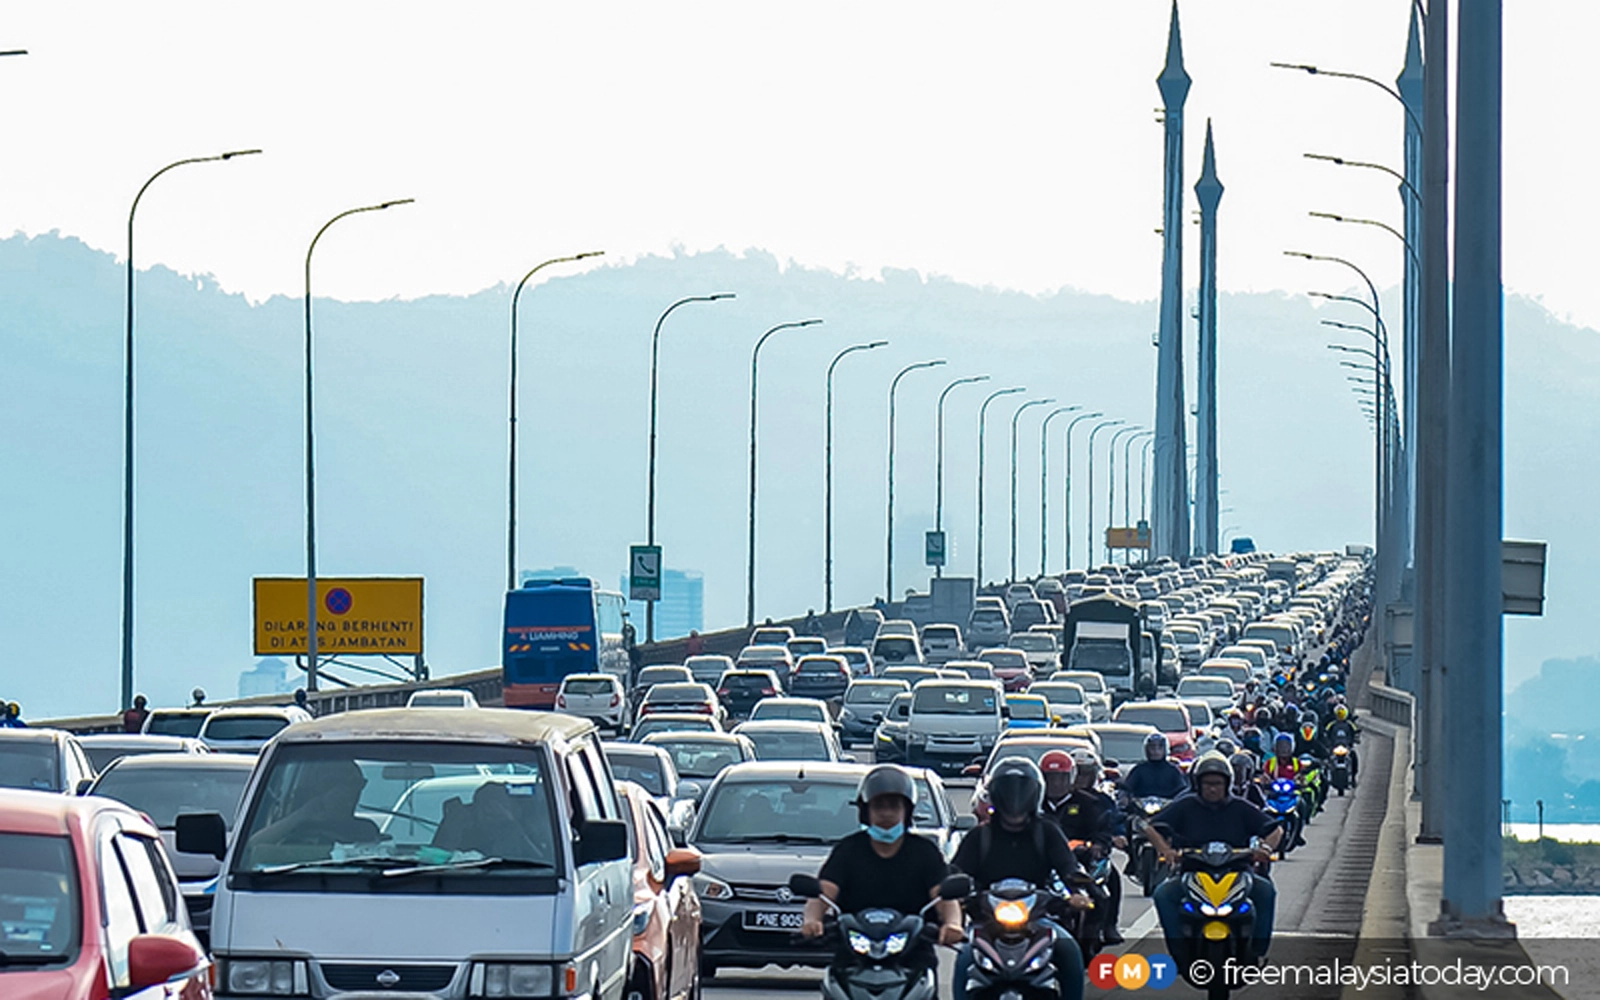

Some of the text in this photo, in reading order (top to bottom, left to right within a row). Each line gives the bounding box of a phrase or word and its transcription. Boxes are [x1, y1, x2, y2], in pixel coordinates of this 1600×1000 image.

[264, 620, 414, 632] DILARNG BERHENTI
[271, 636, 407, 648] DI ATS JAMBATAN
[756, 912, 779, 927] PNE
